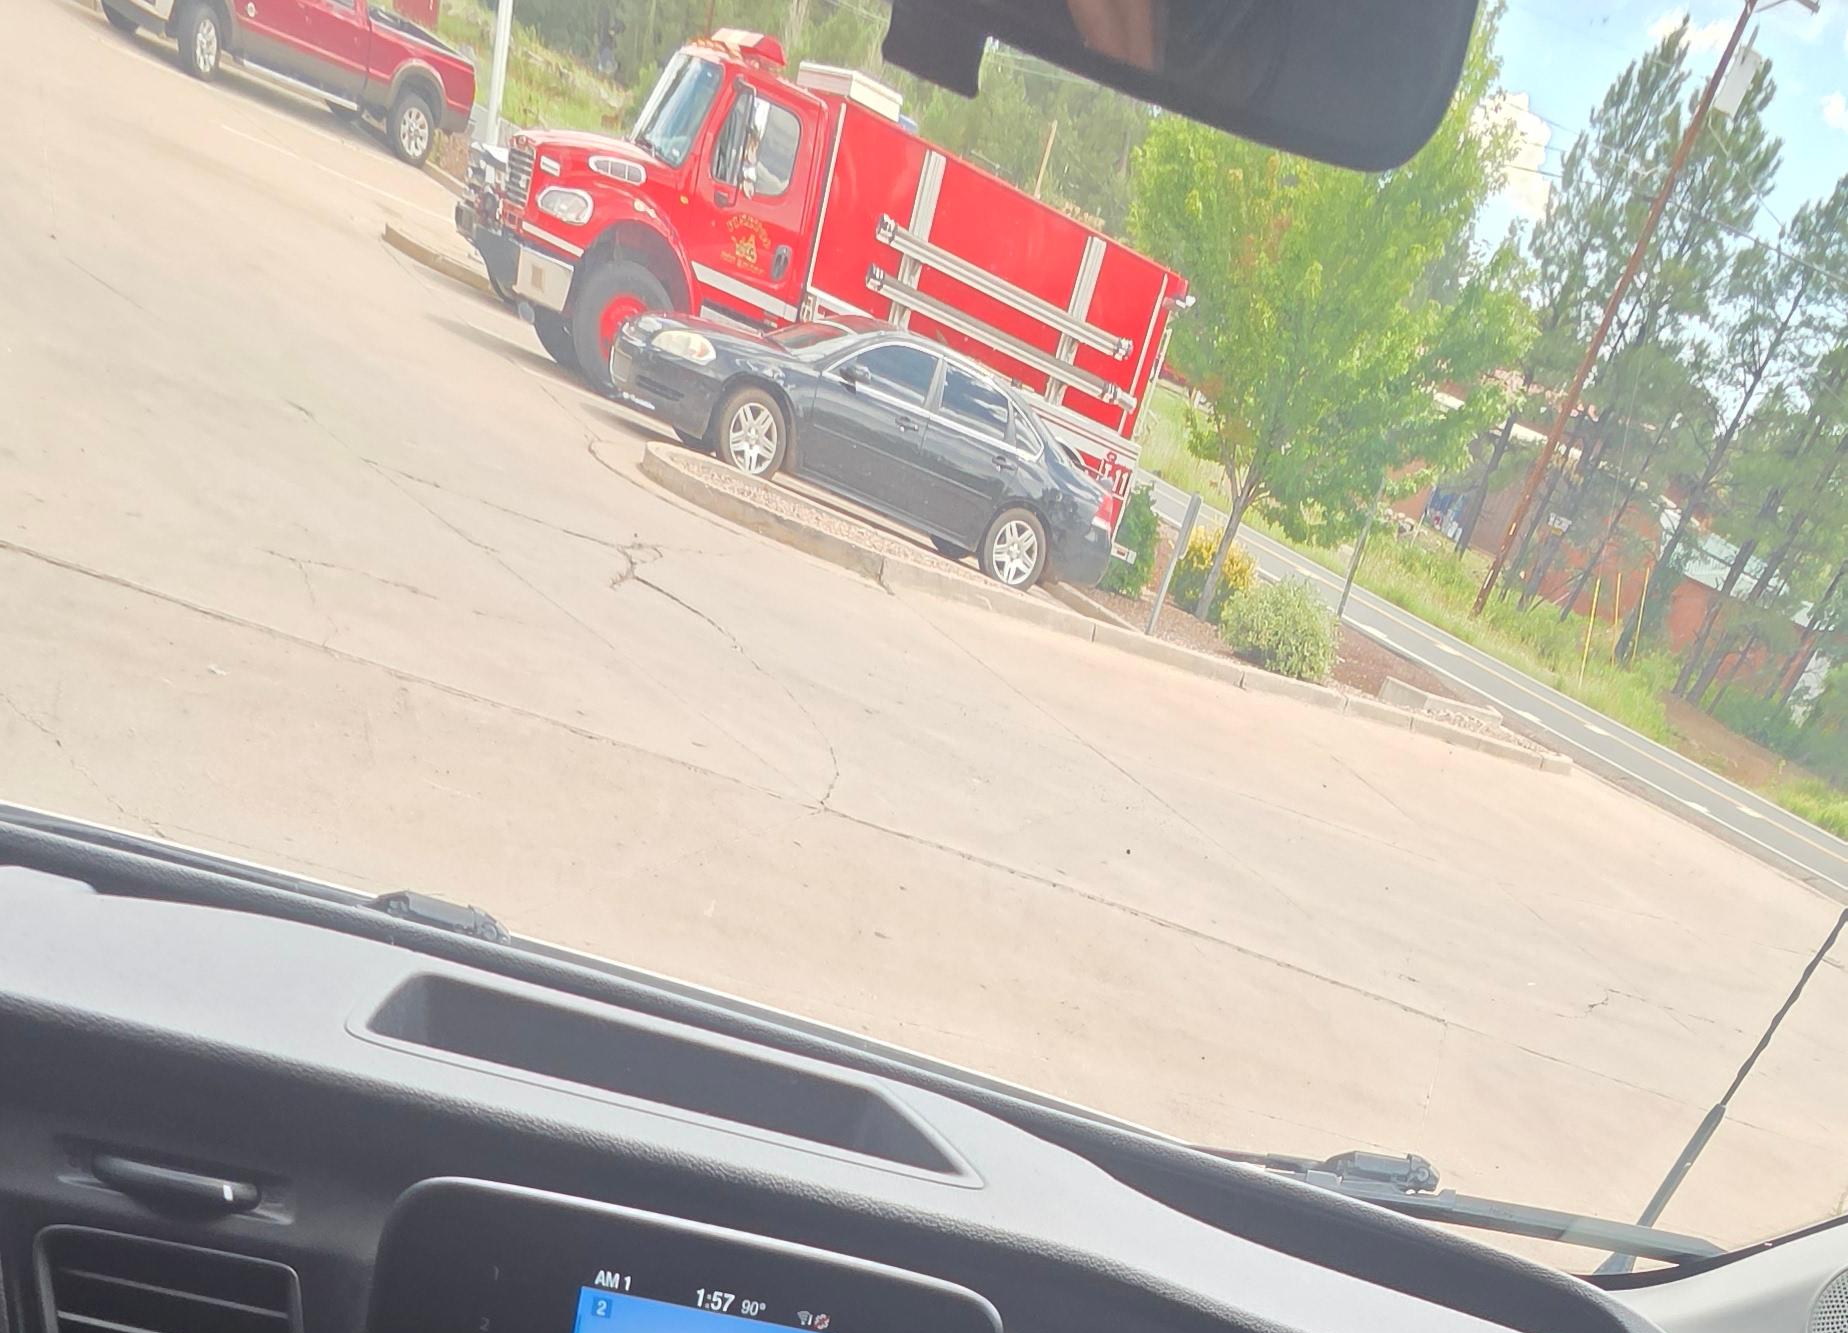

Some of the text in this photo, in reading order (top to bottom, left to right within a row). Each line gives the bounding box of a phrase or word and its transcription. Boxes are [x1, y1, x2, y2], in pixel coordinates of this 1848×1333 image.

[595, 1270, 631, 1291] AM 1
[596, 1302, 606, 1316] 2
[696, 1288, 735, 1312] 1:57
